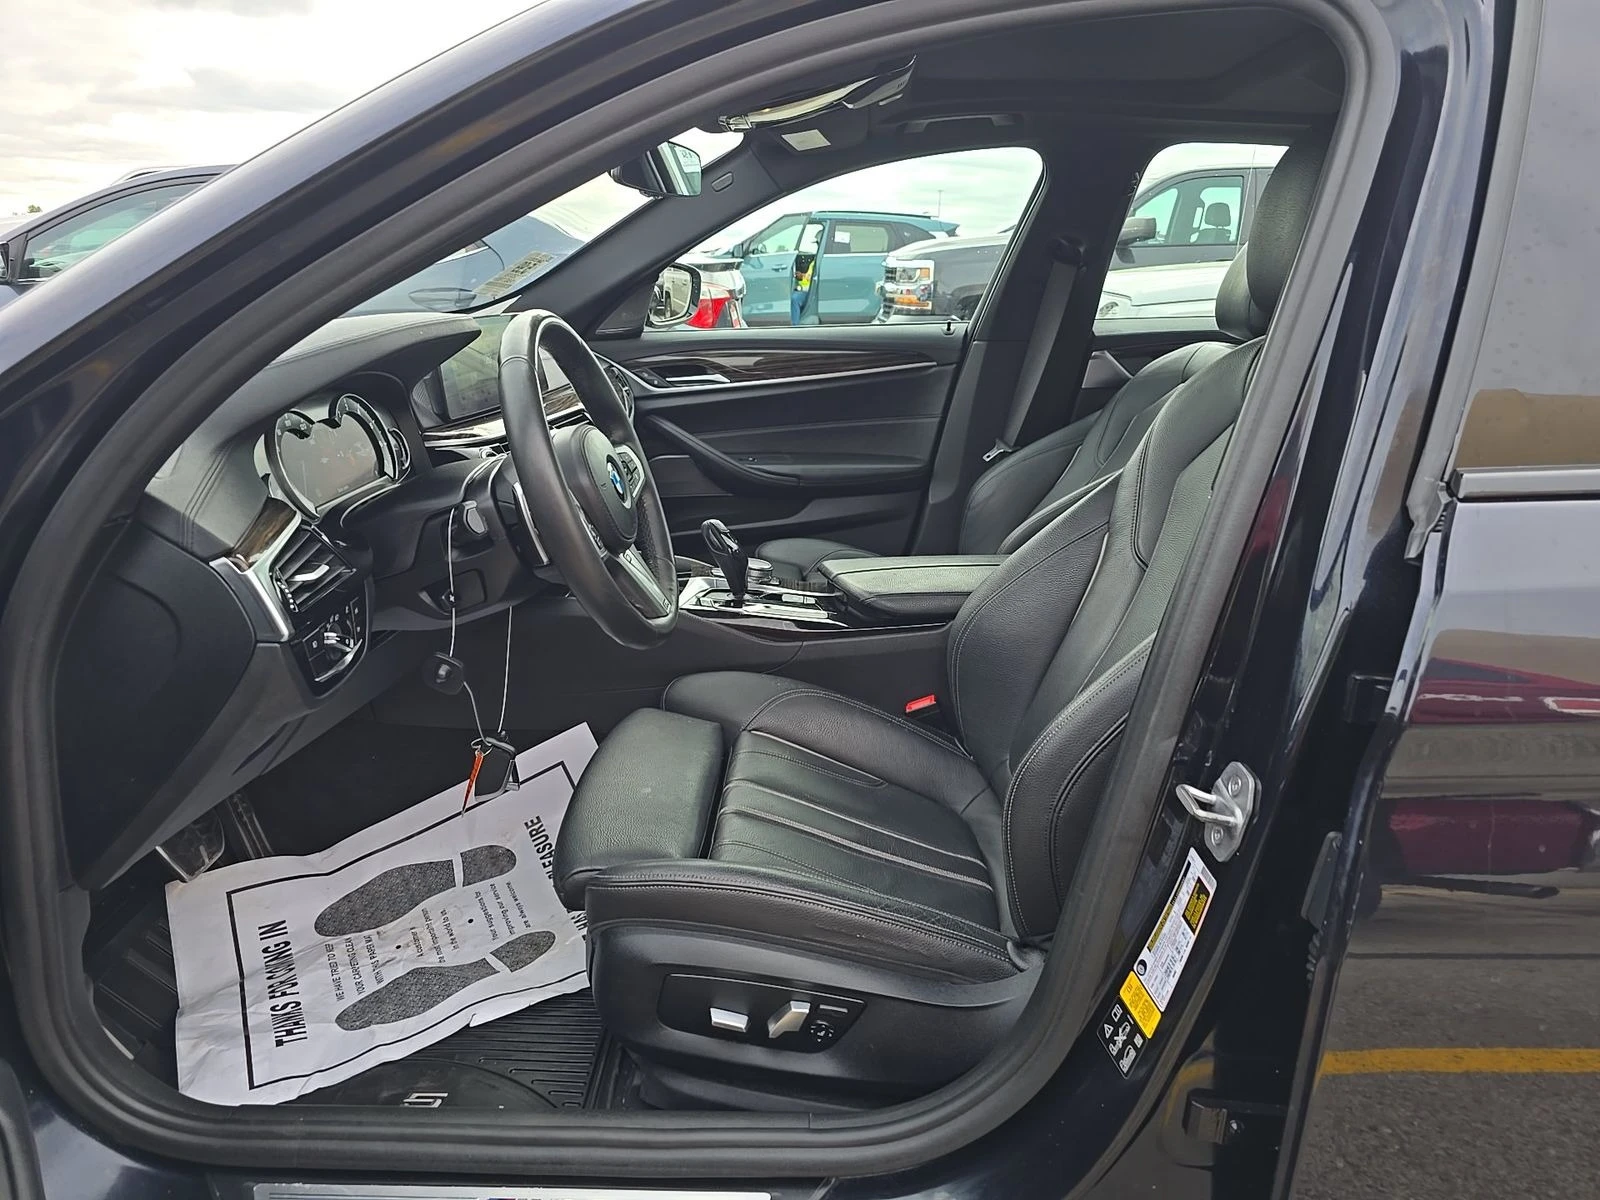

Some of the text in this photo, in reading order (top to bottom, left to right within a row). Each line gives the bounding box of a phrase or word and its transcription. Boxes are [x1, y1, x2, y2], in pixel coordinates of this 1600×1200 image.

[477, 897, 495, 928] suggestions
[501, 909, 516, 936] improving
[326, 953, 336, 961] TO
[344, 937, 366, 995] YOUR CARPETING CLEAN
[258, 920, 308, 1047] THANKS FOR COMING IN
[332, 976, 343, 991] HAVE
[335, 991, 345, 1002] WE
